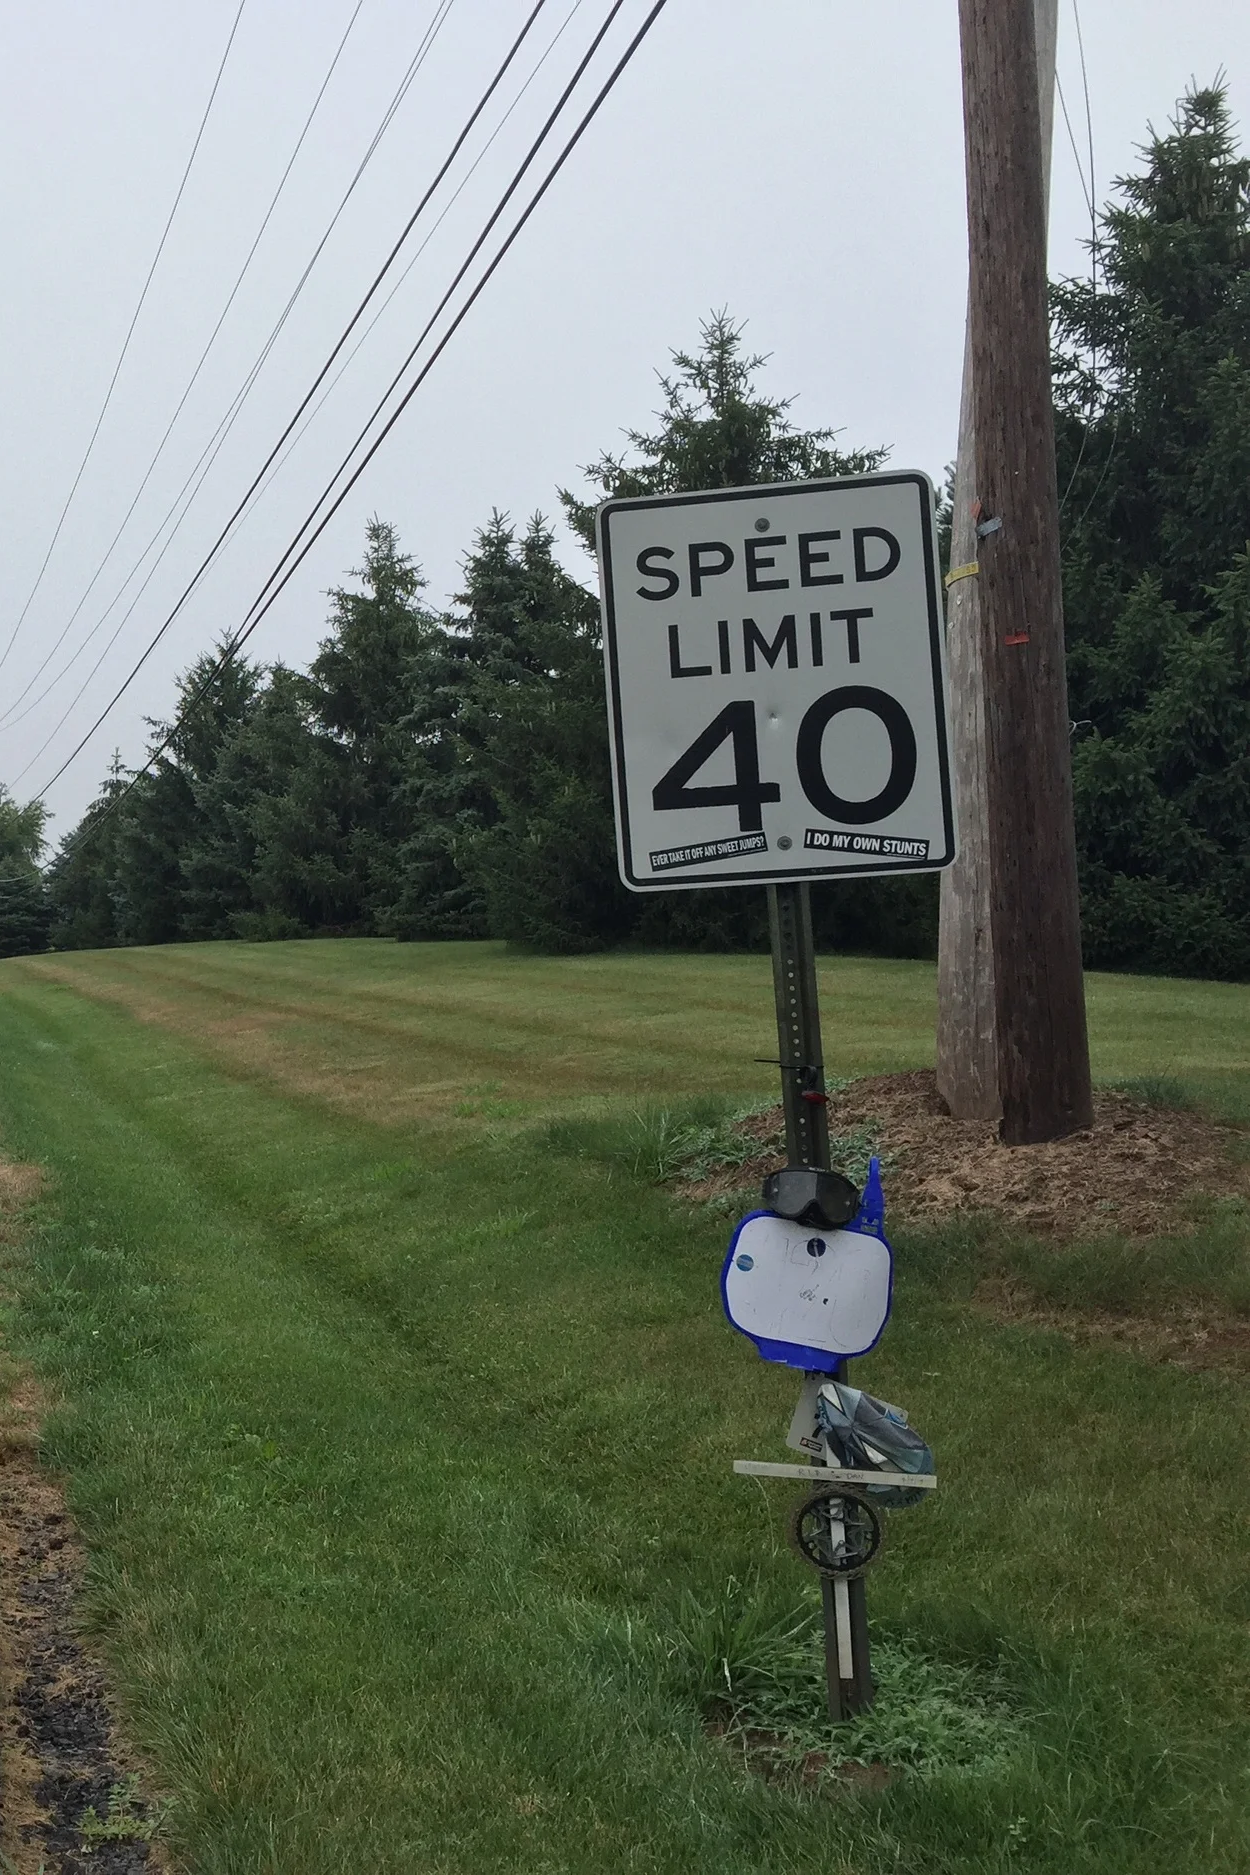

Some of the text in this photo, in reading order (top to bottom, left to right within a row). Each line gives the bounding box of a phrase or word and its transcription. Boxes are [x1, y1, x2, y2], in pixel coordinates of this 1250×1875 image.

[636, 526, 900, 600] SPEED
[668, 607, 873, 678] LIMIT
[652, 685, 917, 832] 40
[651, 835, 765, 866] EVER TAKE IT OFF ANY SWEET JUMPS?
[806, 832, 926, 855] I DO MY OWN STUNTS
